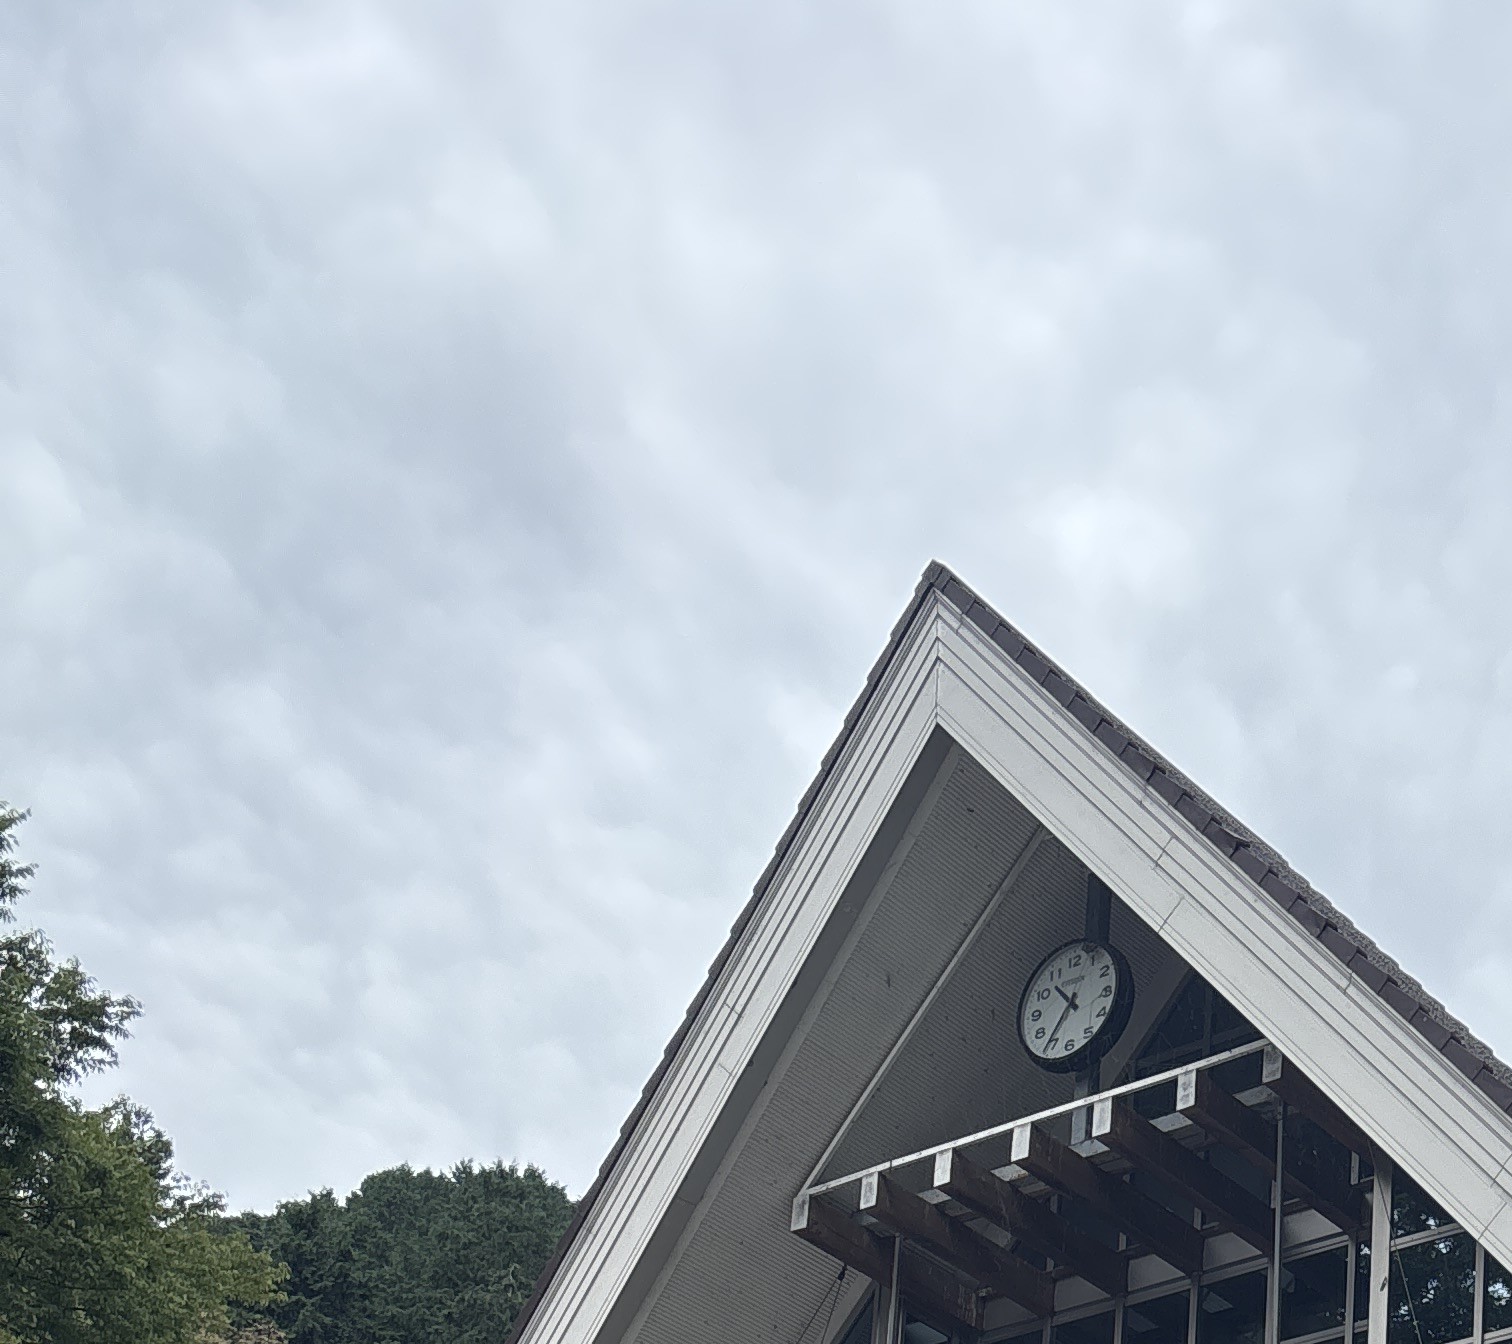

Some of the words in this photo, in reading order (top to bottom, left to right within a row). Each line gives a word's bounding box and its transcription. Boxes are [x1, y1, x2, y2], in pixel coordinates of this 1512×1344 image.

[1068, 955, 1082, 968] 12
[1050, 968, 1062, 981] 11
[1100, 965, 1110, 978] 2
[1036, 988, 1051, 1002] 10
[1031, 1009, 1042, 1021] 9
[1095, 1006, 1107, 1018] 4
[1035, 1027, 1046, 1039] 8
[1083, 1026, 1094, 1039] 5
[1050, 1037, 1059, 1050] 7
[1064, 1039, 1075, 1051] 6
